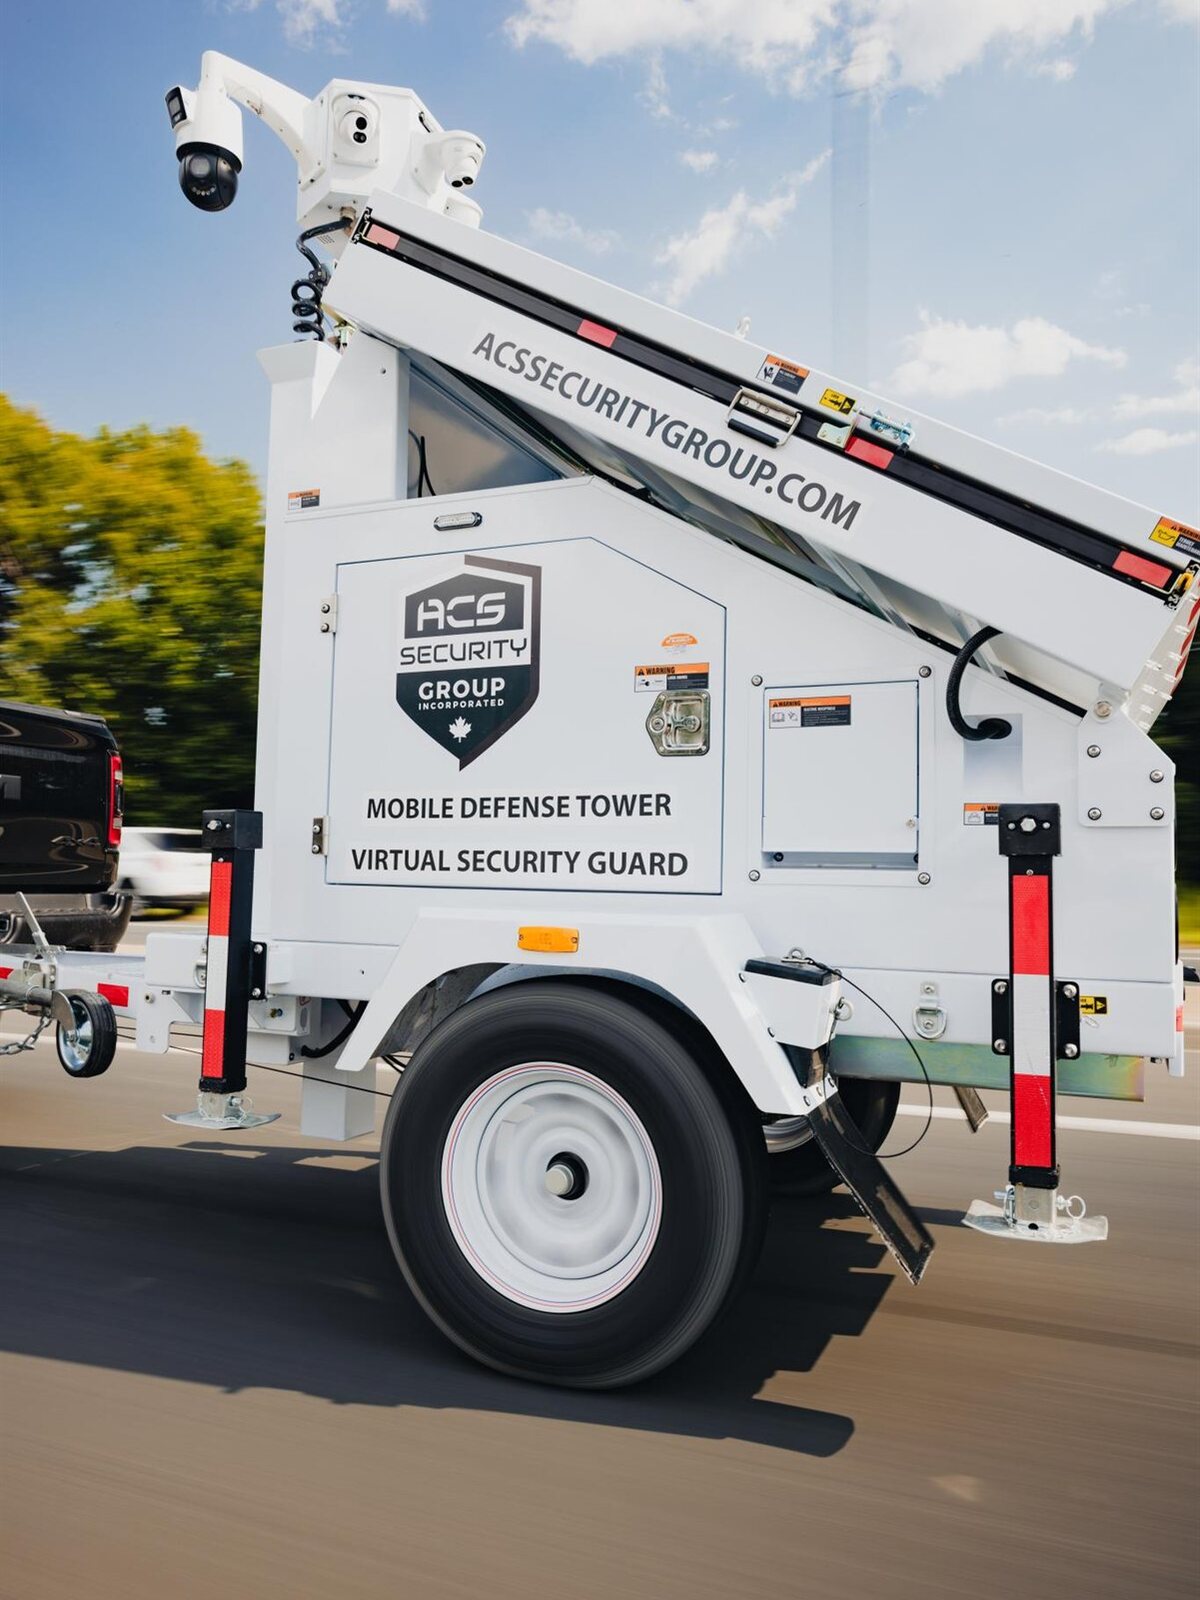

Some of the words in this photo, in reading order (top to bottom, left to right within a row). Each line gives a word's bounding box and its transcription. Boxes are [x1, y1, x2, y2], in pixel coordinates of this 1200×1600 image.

[472, 332, 862, 531] ACSSECURITYGROUP.COM
[417, 592, 506, 632] ACS
[400, 638, 528, 665] SECURITY
[645, 666, 676, 676] WARNING
[418, 677, 506, 700] GROUP
[418, 698, 505, 711] INCORPORATED
[367, 797, 454, 819] MOBILE
[460, 795, 570, 819] DEFENSE
[576, 793, 672, 818] TOWER
[351, 848, 450, 872] VIRTUAL
[457, 849, 581, 874] SECURITY
[587, 851, 689, 877] GUARD
